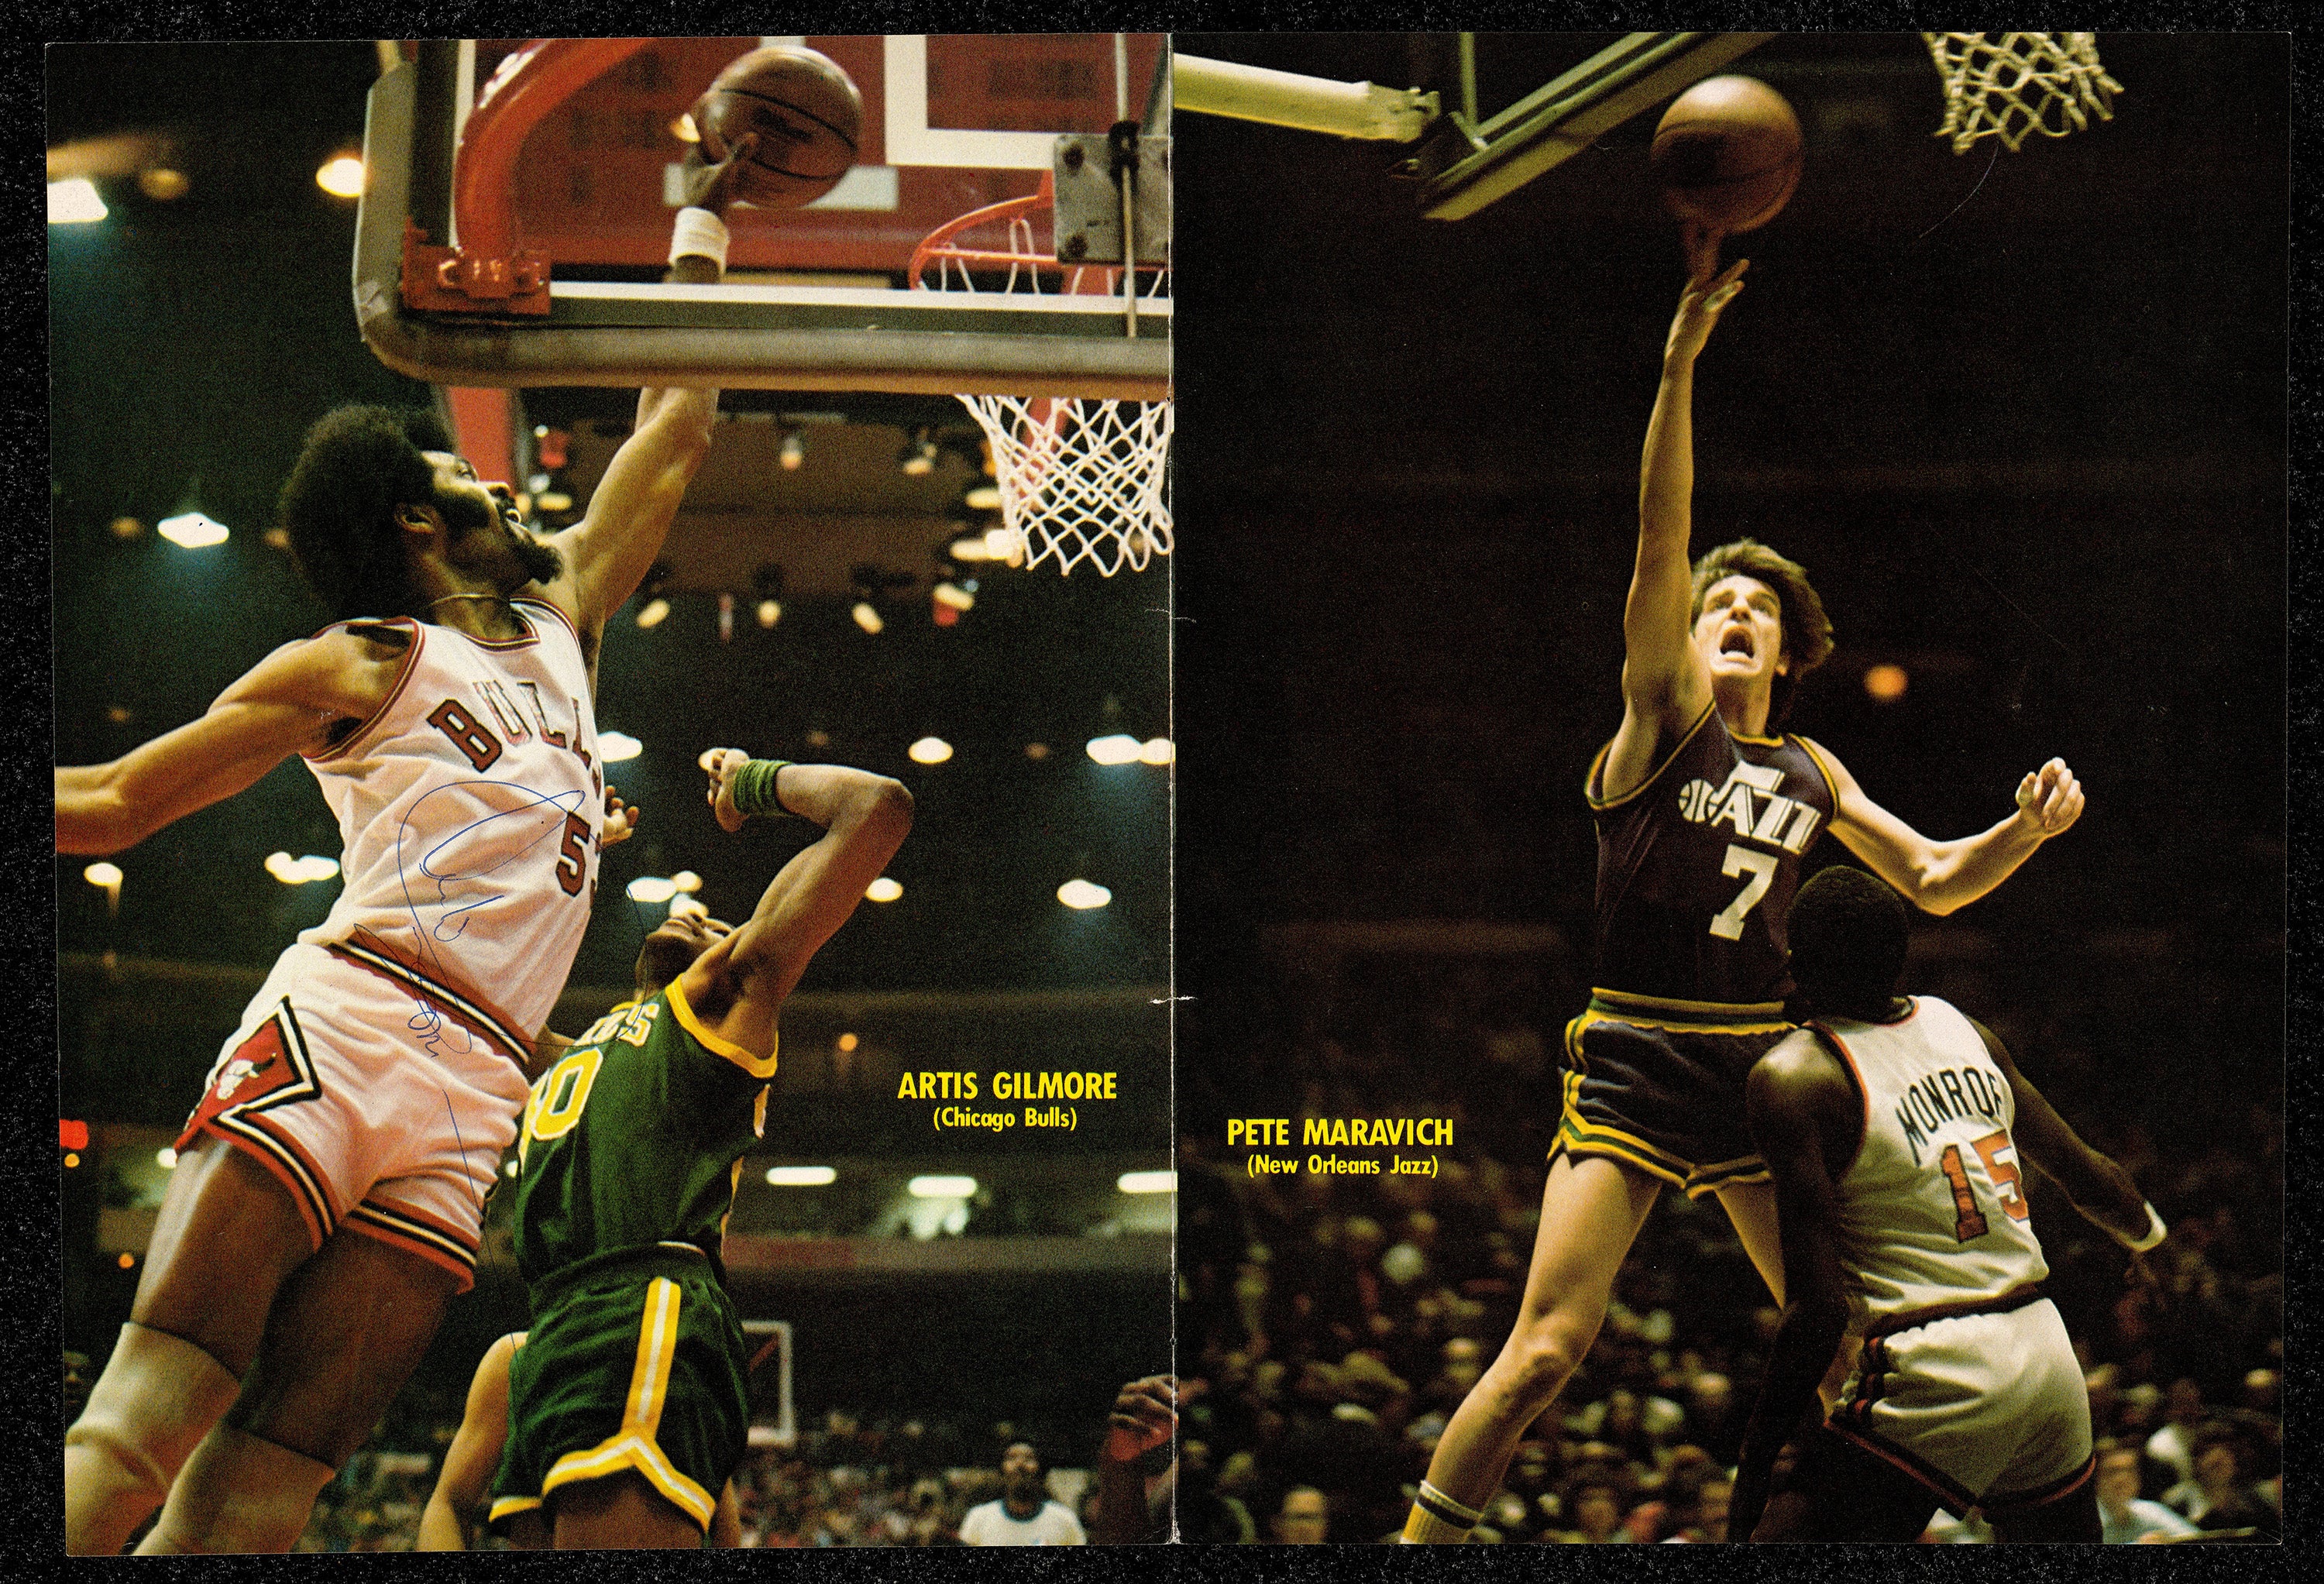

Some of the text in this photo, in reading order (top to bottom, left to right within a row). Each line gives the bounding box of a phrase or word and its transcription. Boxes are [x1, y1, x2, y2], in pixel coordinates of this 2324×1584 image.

[426, 679, 602, 800] BULL
[1678, 760, 1821, 854] JAZZ
[555, 810, 602, 917] 5
[1708, 844, 1779, 941] 7
[1941, 1128, 2030, 1243] 15
